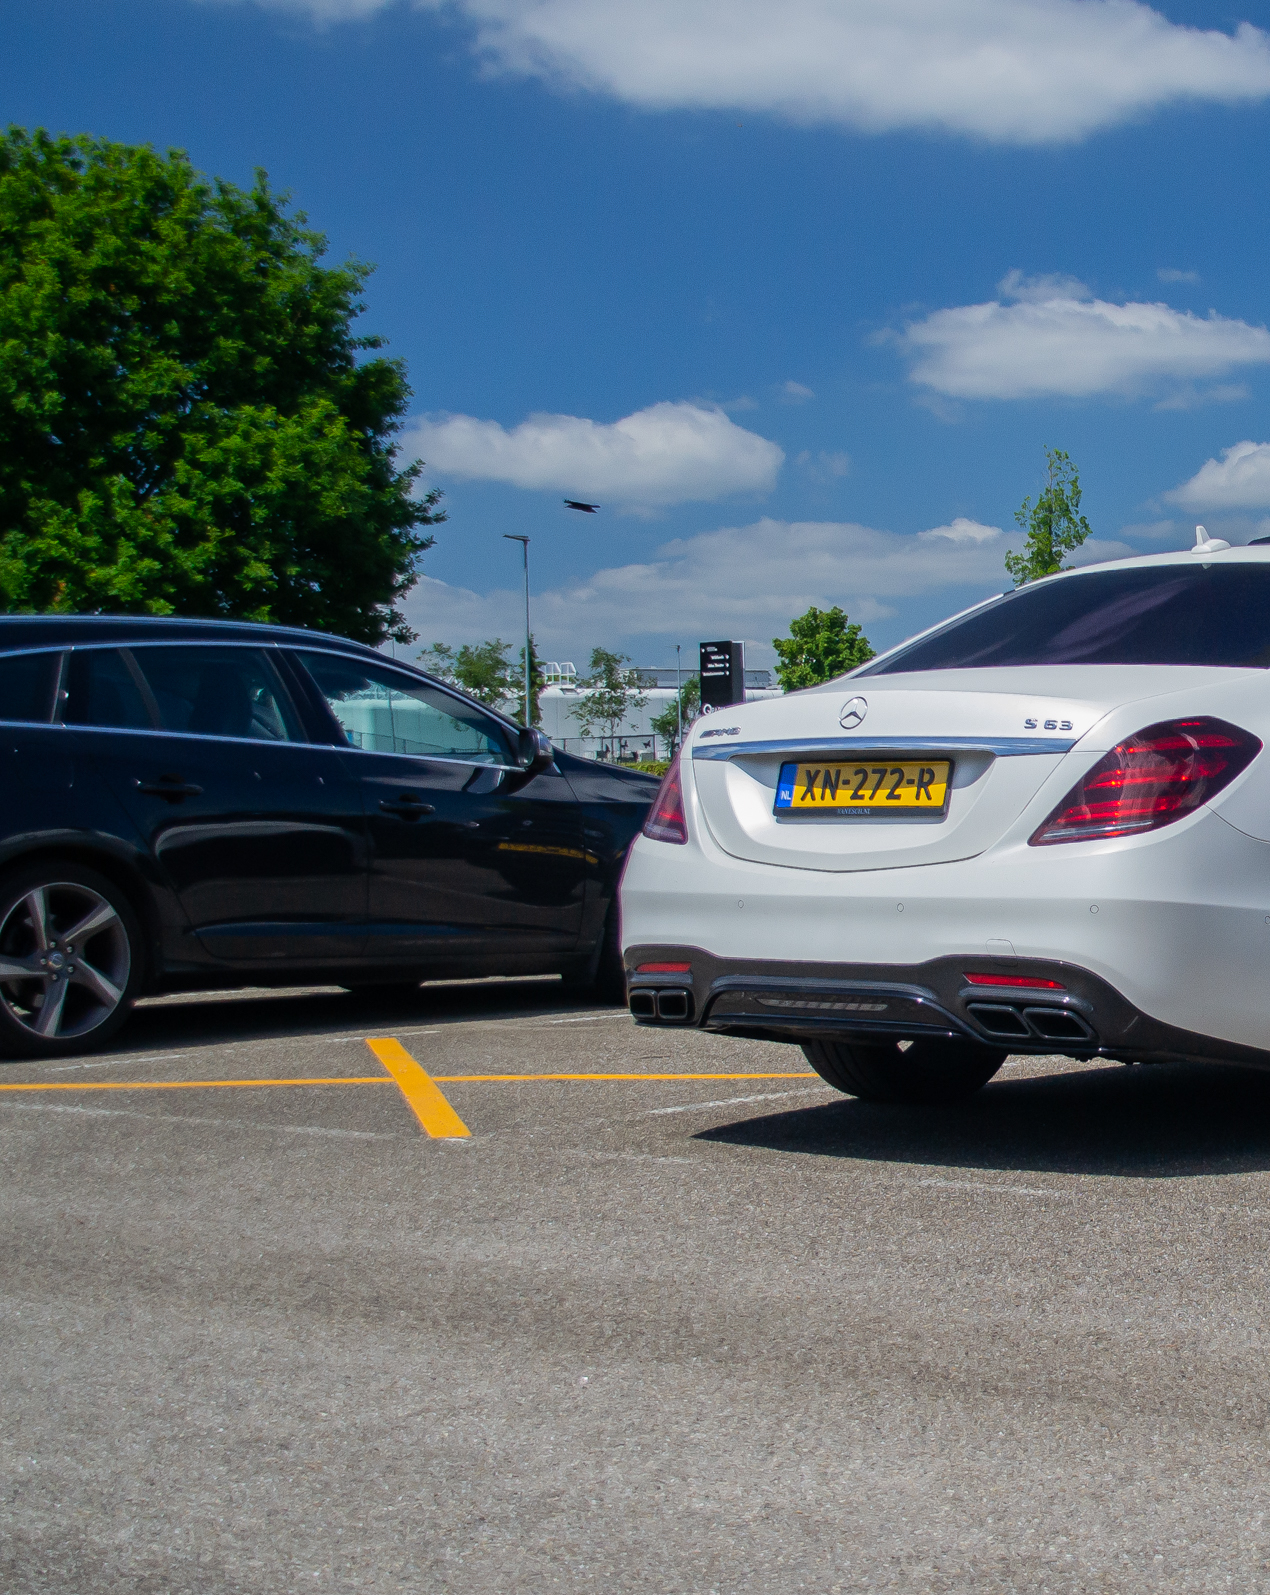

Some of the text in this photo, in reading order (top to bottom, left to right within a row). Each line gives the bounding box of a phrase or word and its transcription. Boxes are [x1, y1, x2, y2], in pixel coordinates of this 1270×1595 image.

[1024, 718, 1073, 730] S 63
[800, 767, 936, 802] XN-272-R
[780, 790, 792, 801] NL
